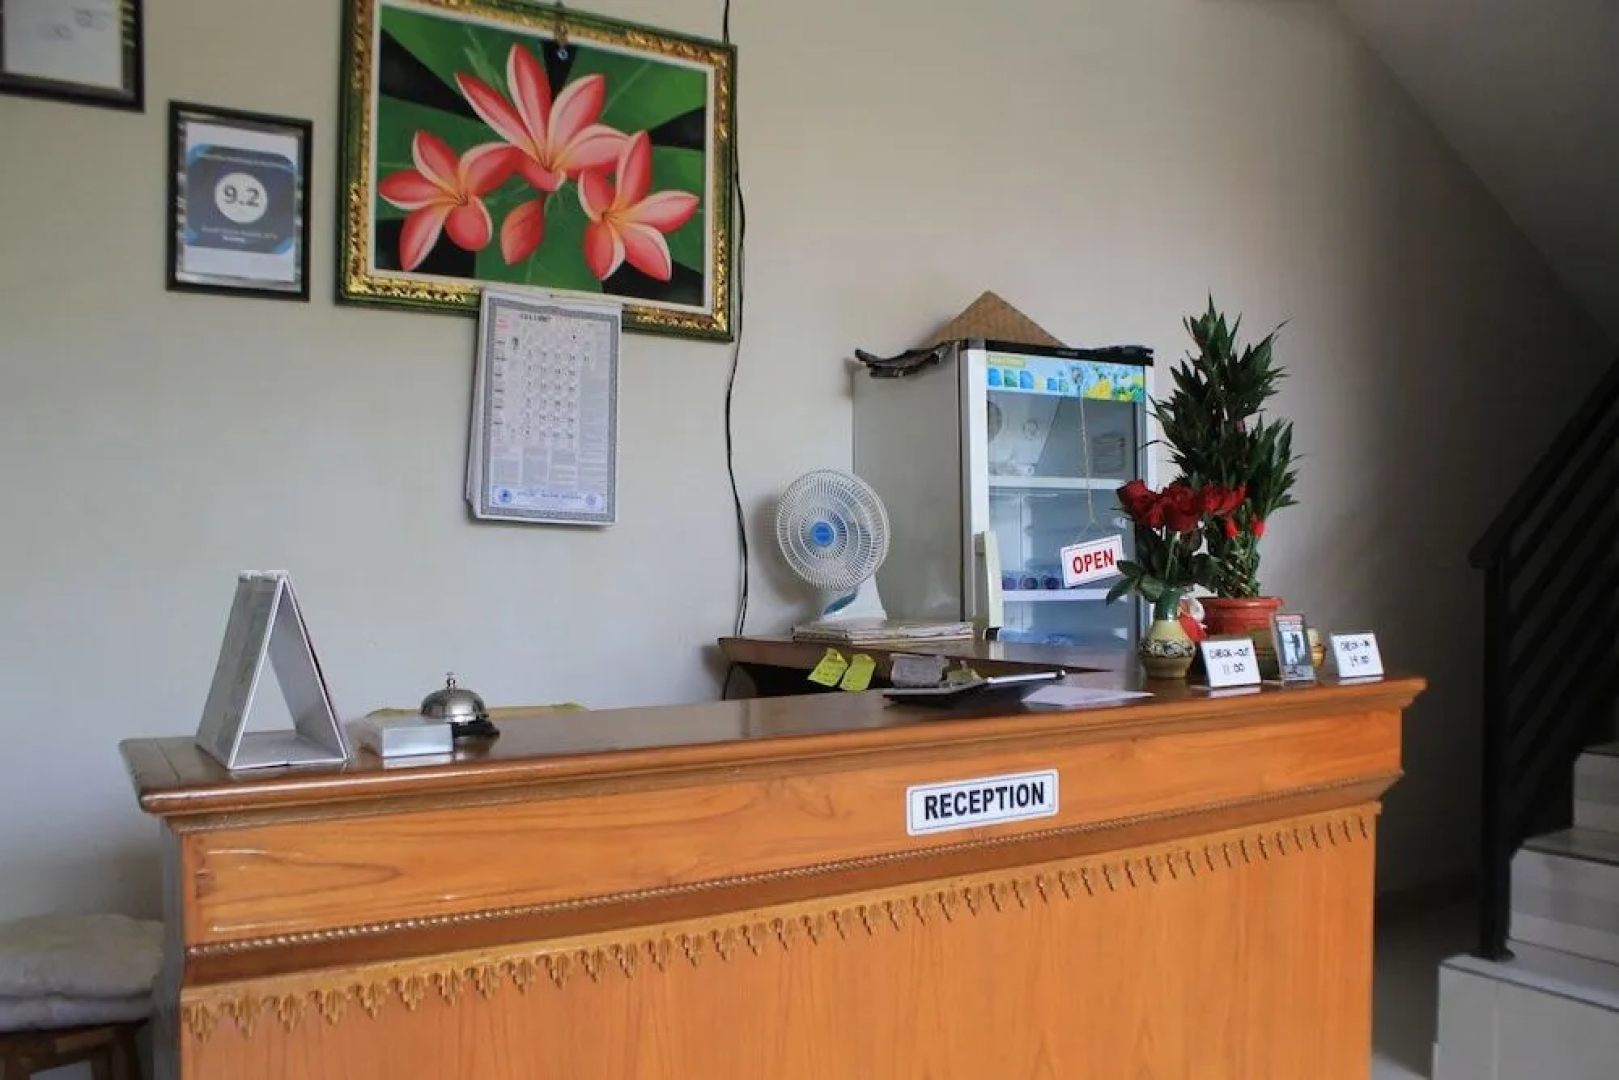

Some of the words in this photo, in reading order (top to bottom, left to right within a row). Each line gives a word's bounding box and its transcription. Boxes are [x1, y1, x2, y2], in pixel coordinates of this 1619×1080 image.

[223, 184, 260, 208] 9.2
[1072, 548, 1115, 575] OPEN
[924, 781, 1044, 820] RECEPTION
